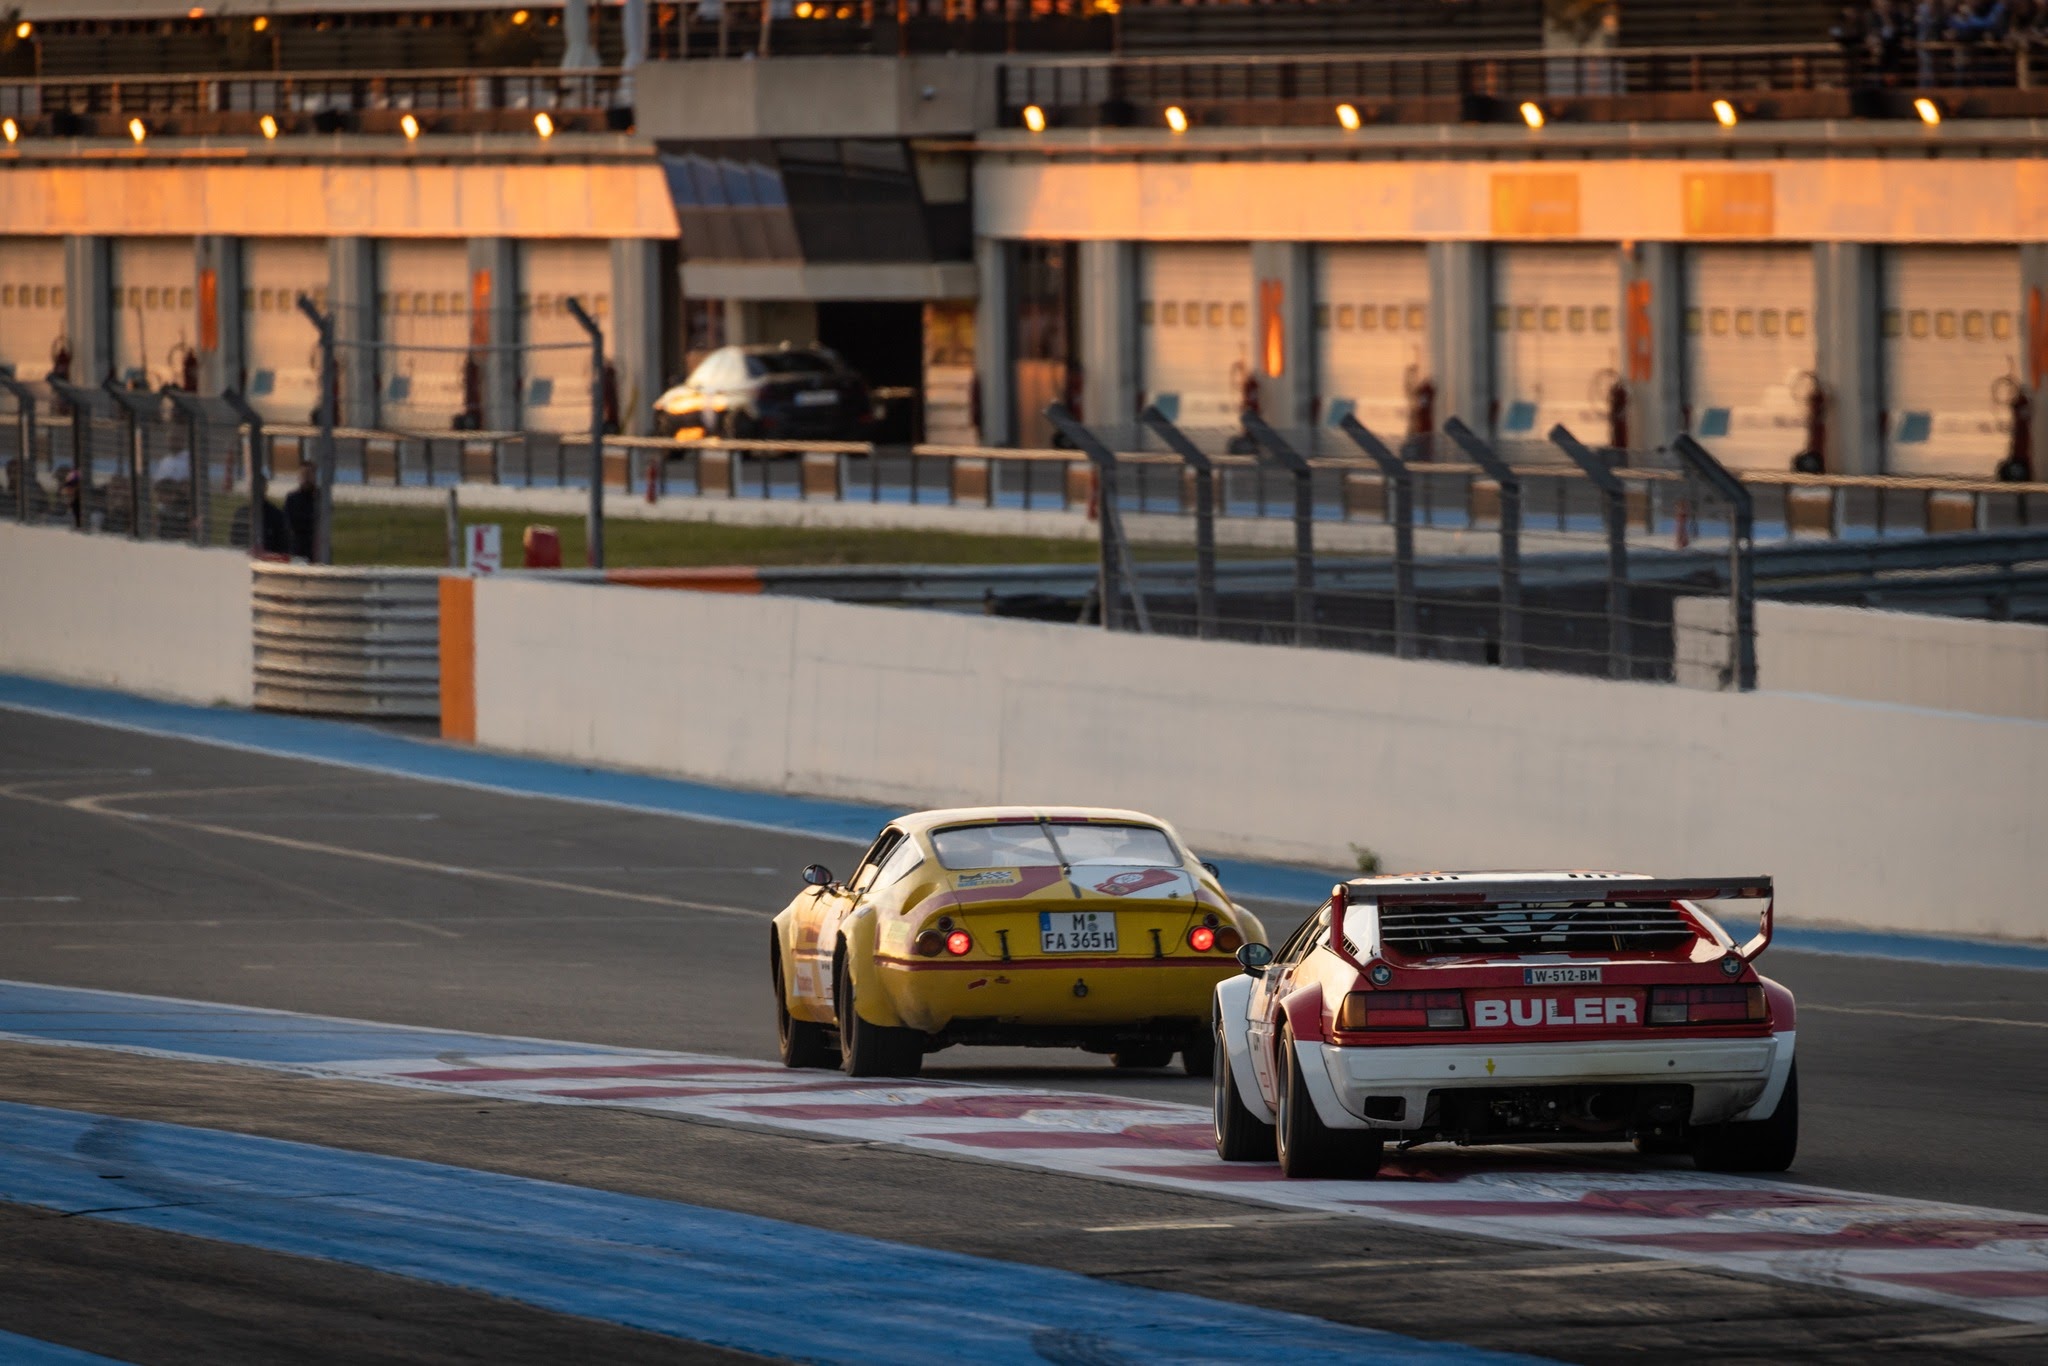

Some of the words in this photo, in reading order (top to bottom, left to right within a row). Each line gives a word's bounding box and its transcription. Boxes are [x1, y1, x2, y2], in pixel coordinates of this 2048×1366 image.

[1072, 913, 1086, 931] M
[1044, 933, 1067, 950] FA
[1534, 969, 1599, 983] W-512-BM
[1474, 997, 1639, 1027] BULER
